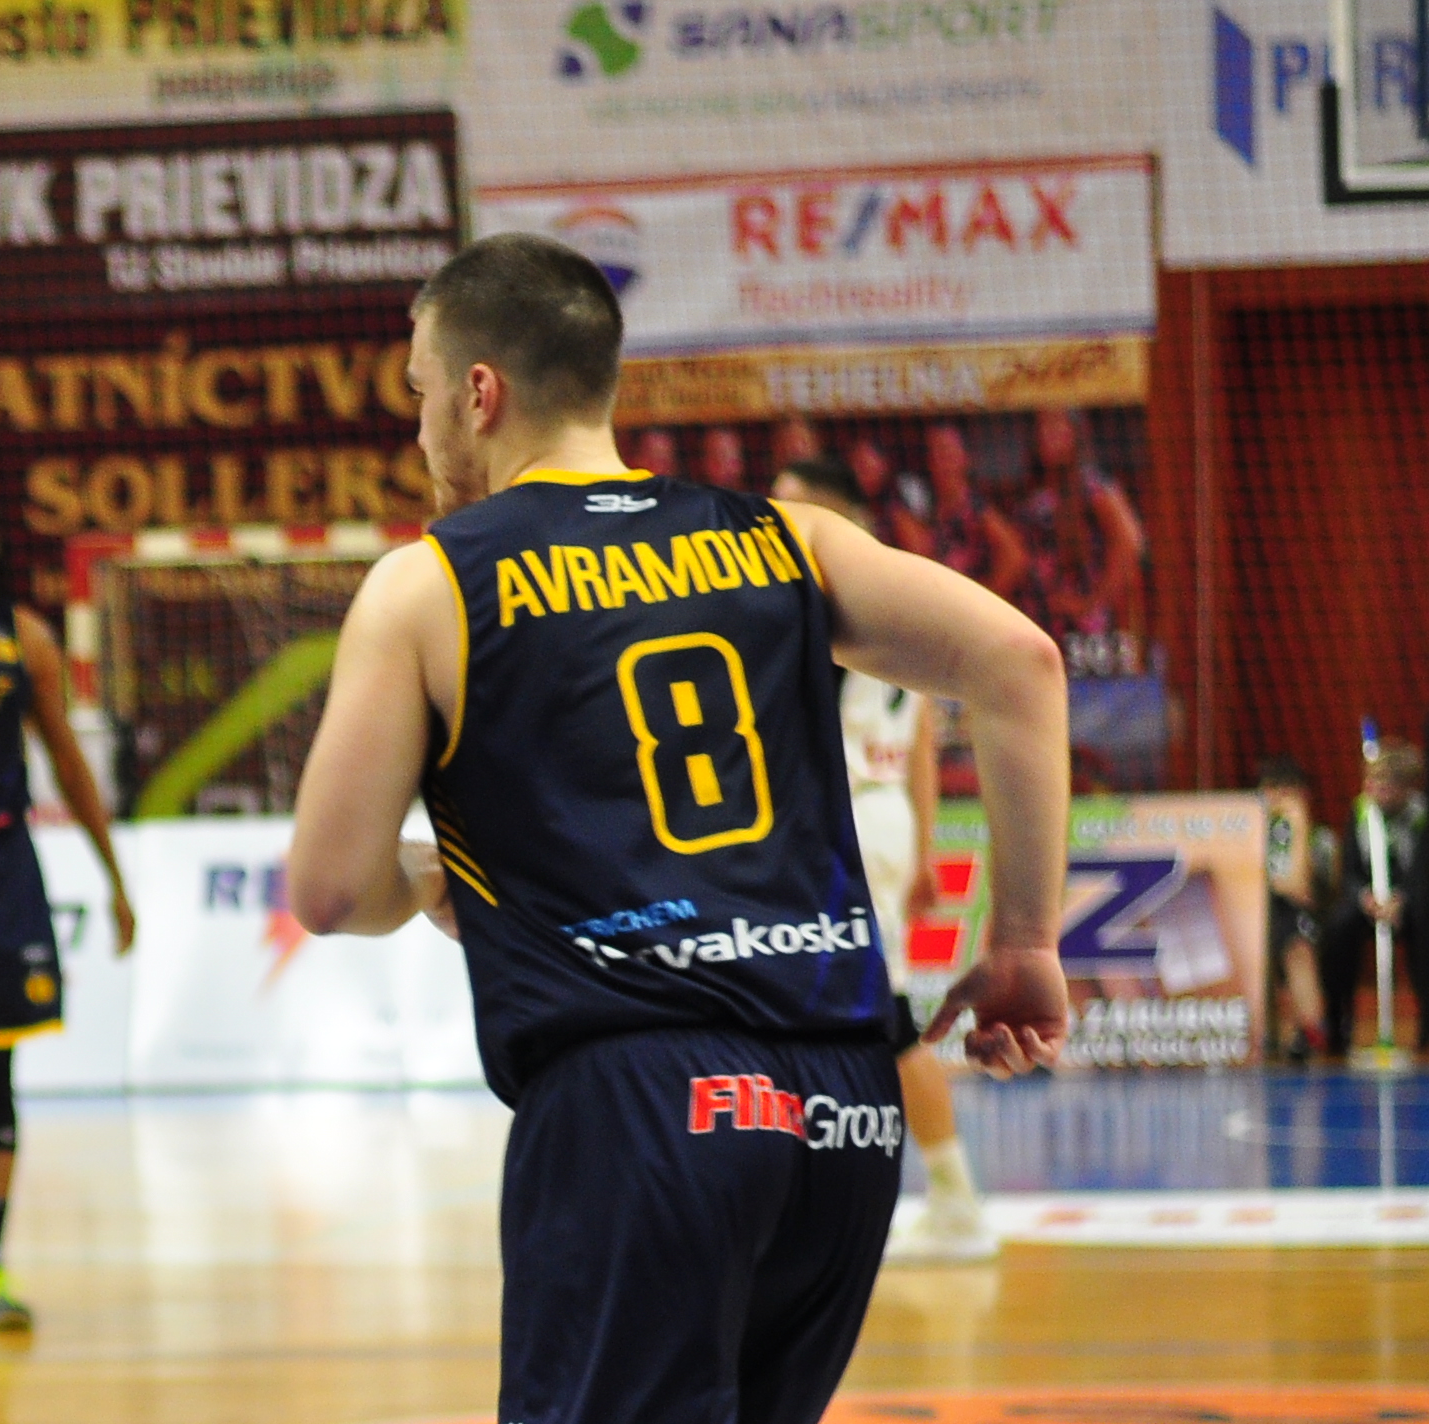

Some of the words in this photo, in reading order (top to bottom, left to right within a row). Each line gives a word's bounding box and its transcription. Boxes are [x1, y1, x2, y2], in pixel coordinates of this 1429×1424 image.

[72, 140, 451, 246] PRIEVIDZA
[729, 184, 1081, 263] RE/MAX
[616, 631, 775, 855] 8
